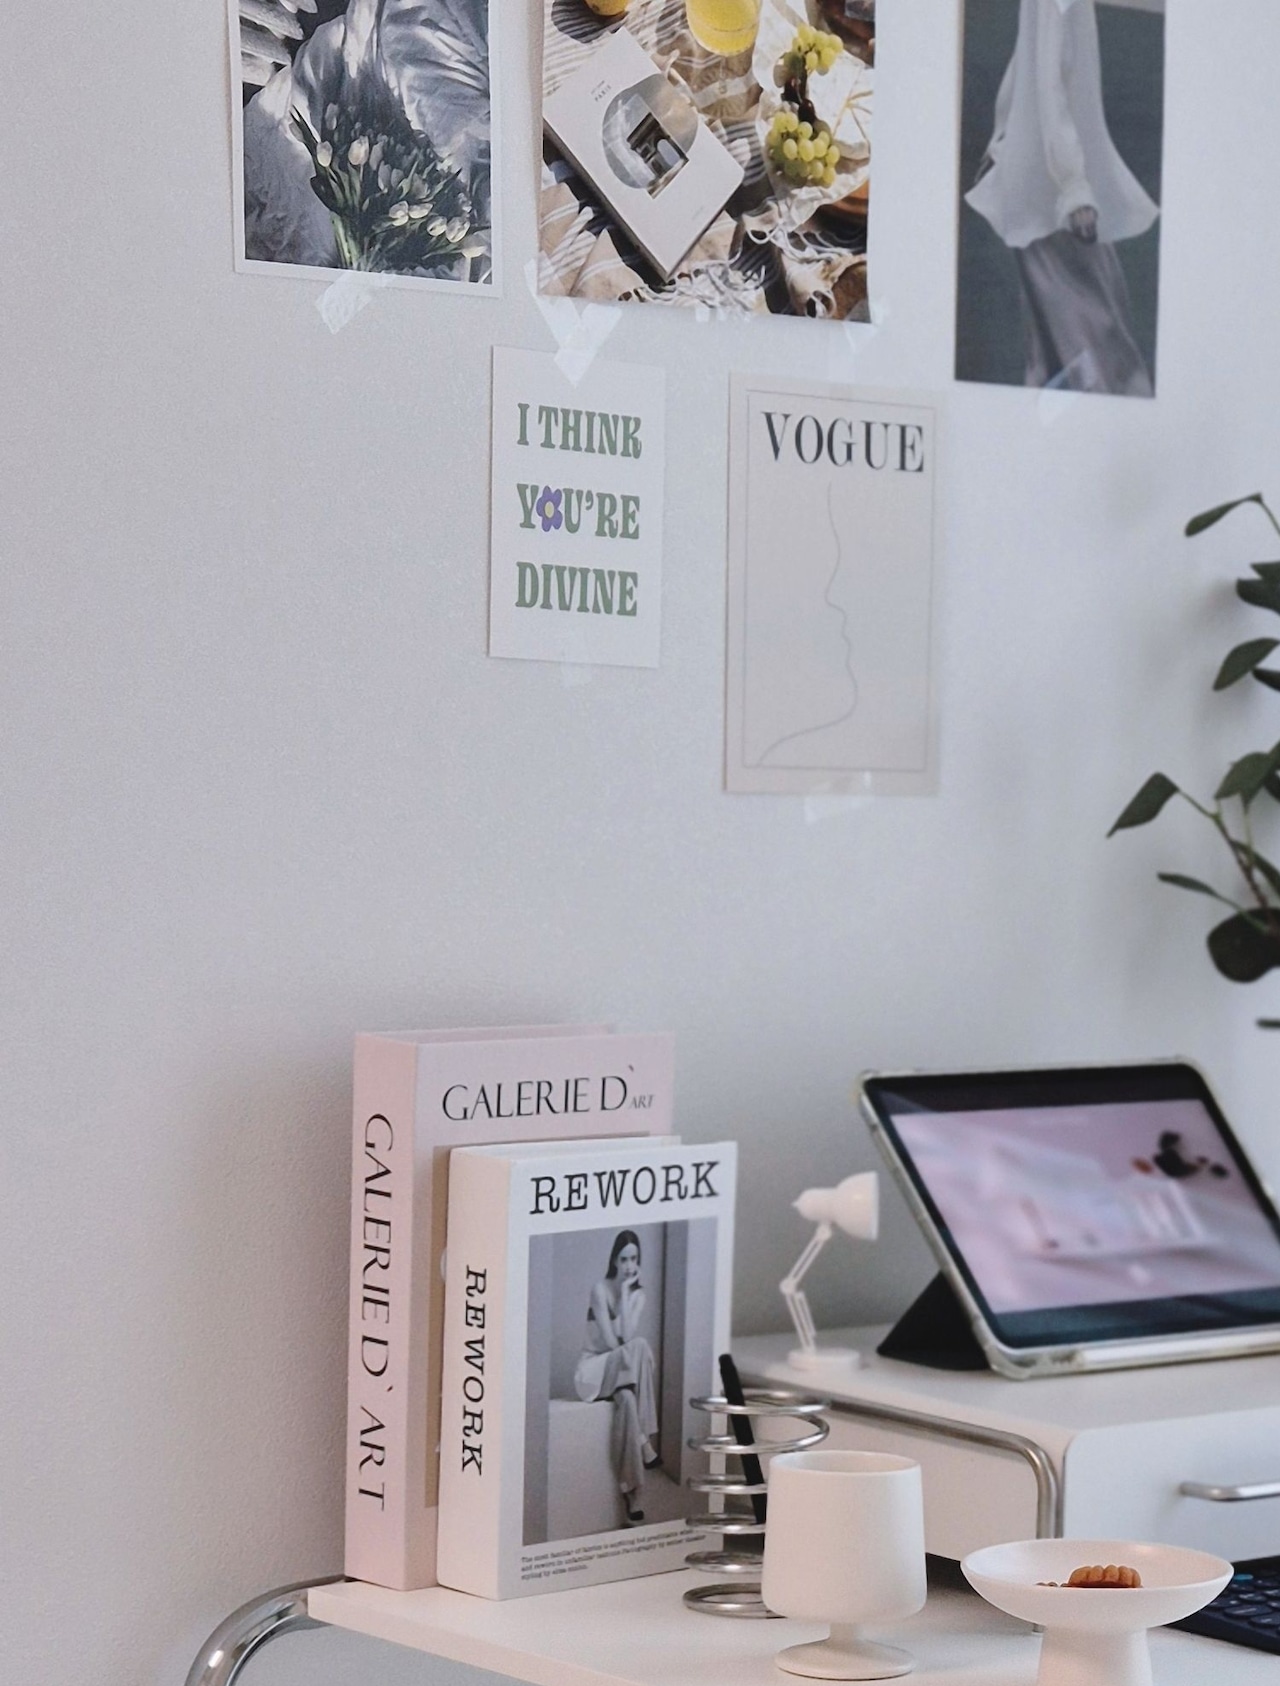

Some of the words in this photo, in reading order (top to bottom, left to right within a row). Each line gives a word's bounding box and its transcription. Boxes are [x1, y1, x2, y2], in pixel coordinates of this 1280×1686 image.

[516, 402, 531, 446] I
[538, 405, 643, 459] THINK
[761, 412, 925, 473] VOGUE
[515, 561, 639, 617] DIVINE
[442, 1077, 591, 1121] GALERIE
[529, 1160, 720, 1215] REWORK
[361, 1113, 394, 1324] GALERIE
[461, 1264, 488, 1477] REWORK
